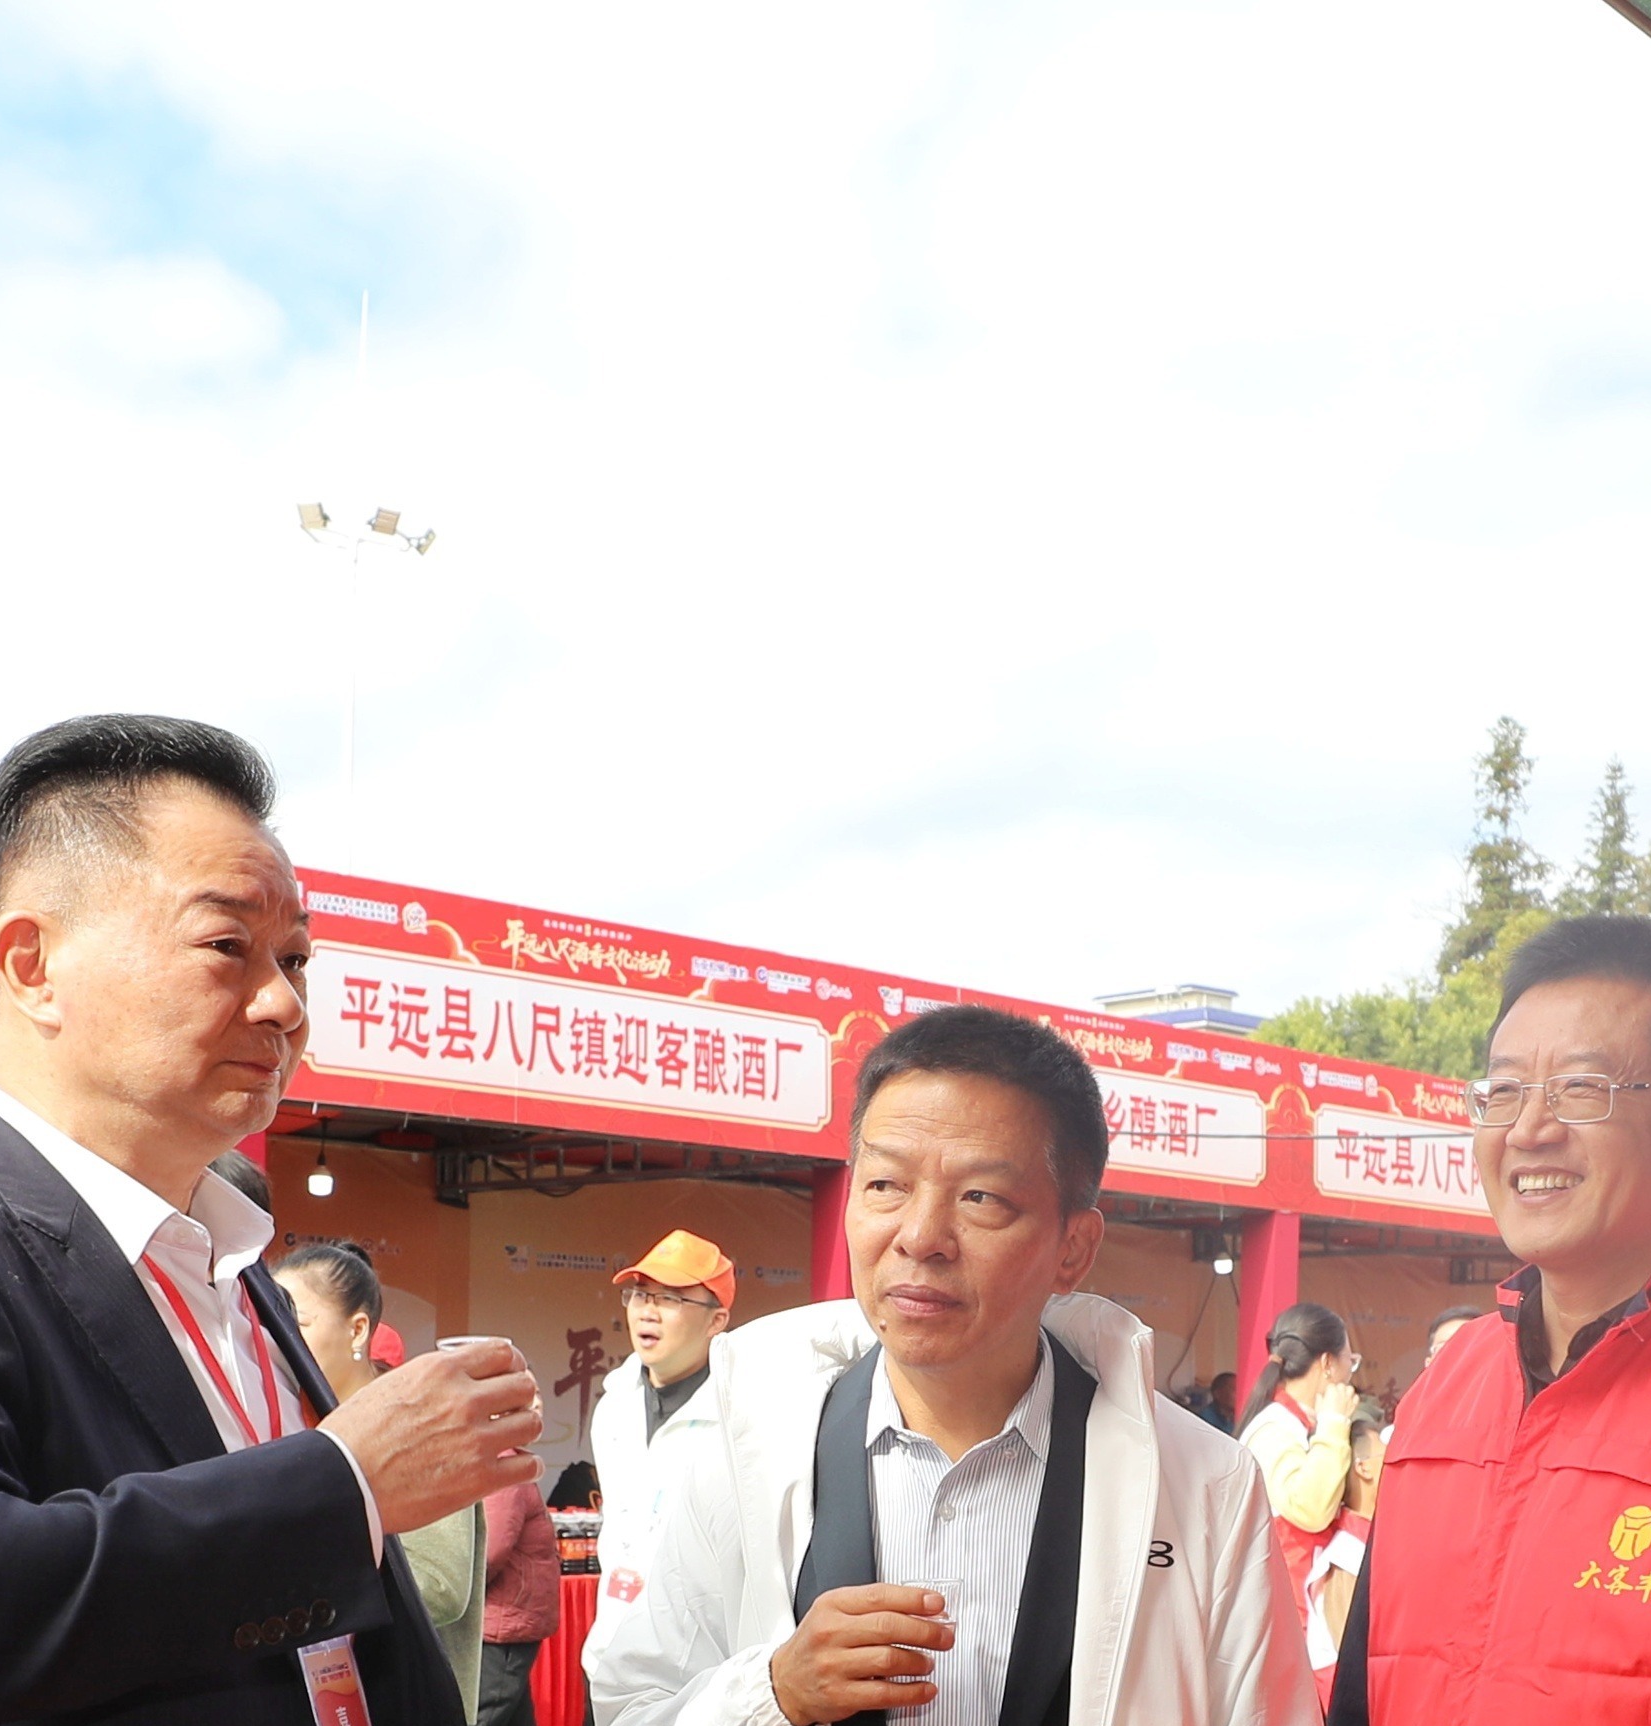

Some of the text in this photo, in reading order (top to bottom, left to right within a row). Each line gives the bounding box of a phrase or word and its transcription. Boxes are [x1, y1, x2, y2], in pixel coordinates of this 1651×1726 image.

[340, 976, 806, 1102] 平远县八尺镇迎客酿酒厂
[1335, 1127, 1481, 1198] 平远县八尺
